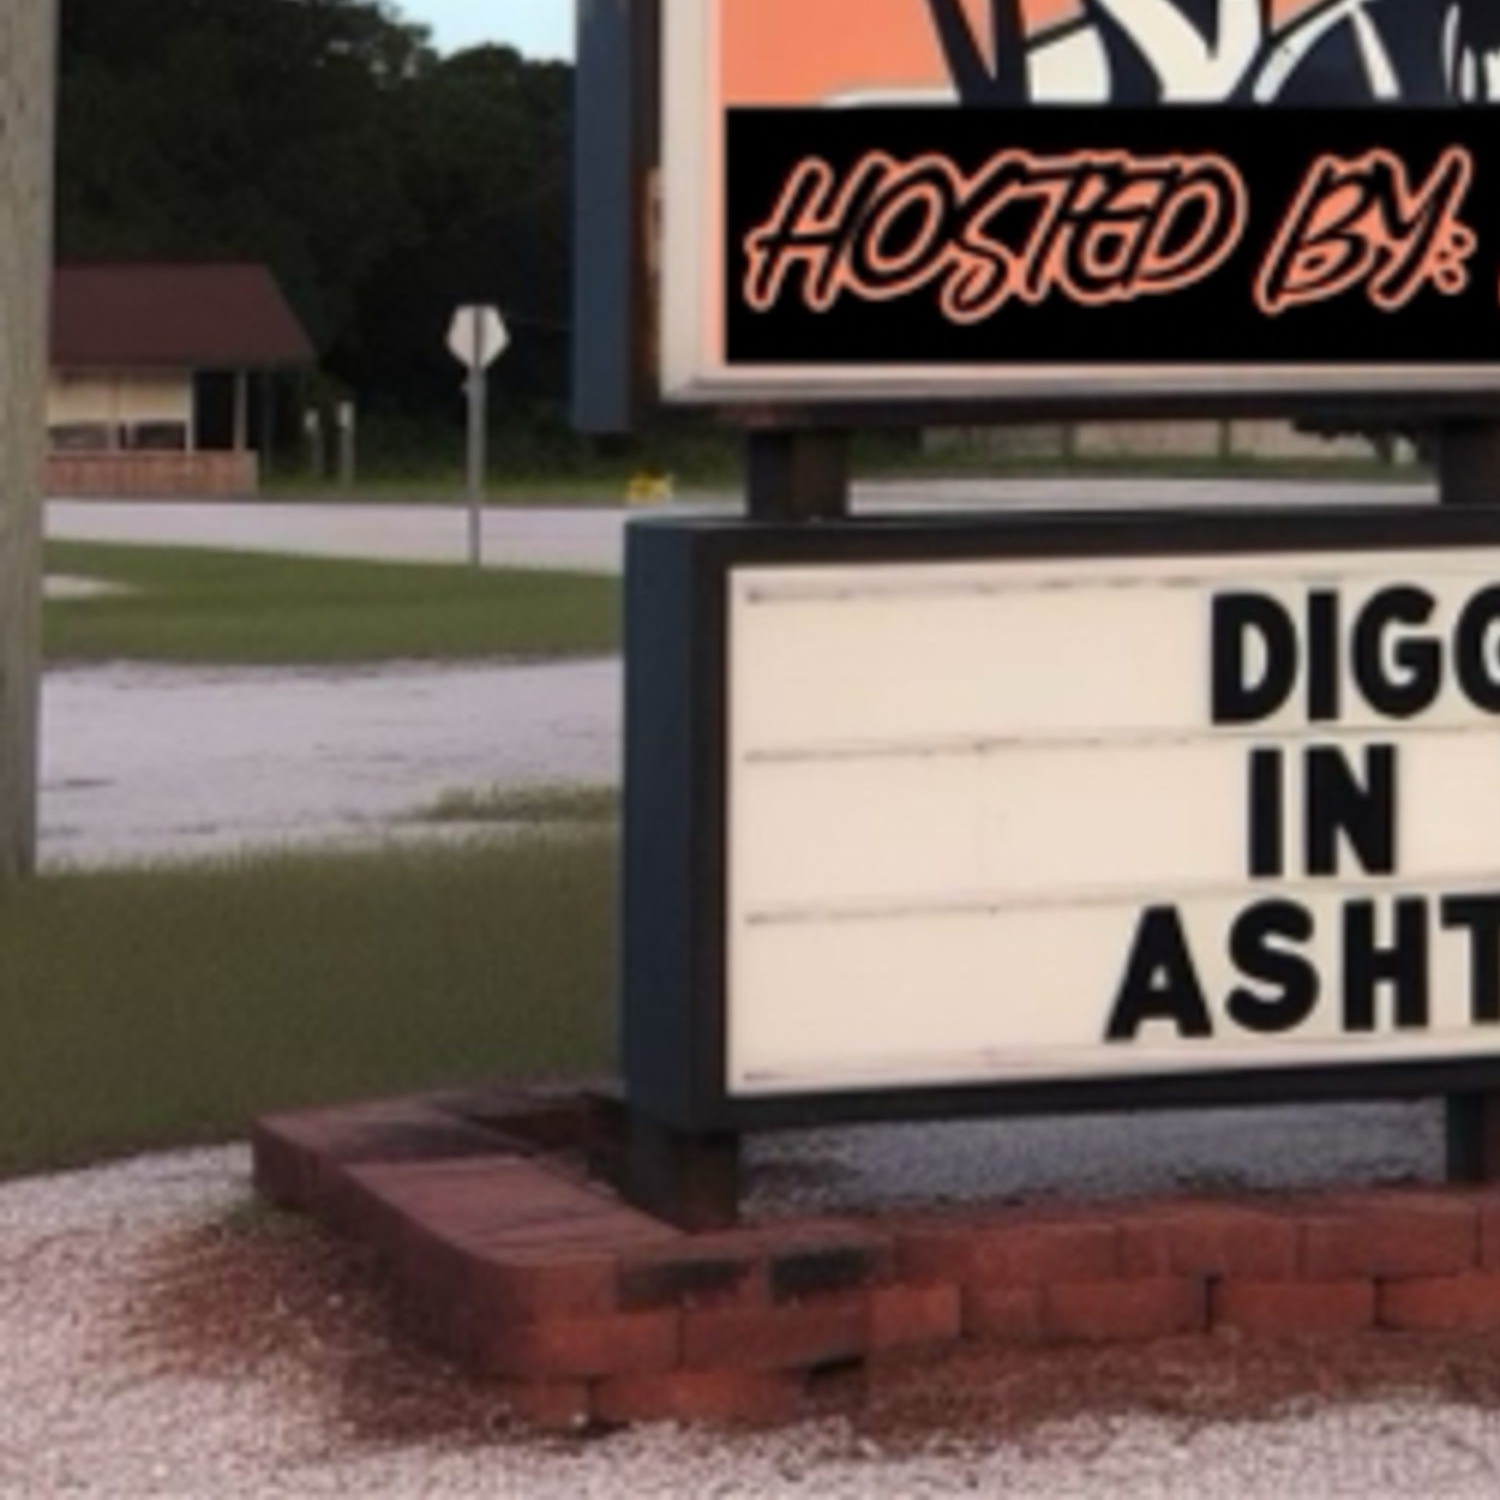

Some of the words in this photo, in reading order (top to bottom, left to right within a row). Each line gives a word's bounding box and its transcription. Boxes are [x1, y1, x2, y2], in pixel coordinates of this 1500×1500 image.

[745, 150, 1245, 322] HOSTED
[1254, 149, 1475, 316] BY:
[1250, 745, 1394, 876] IN
